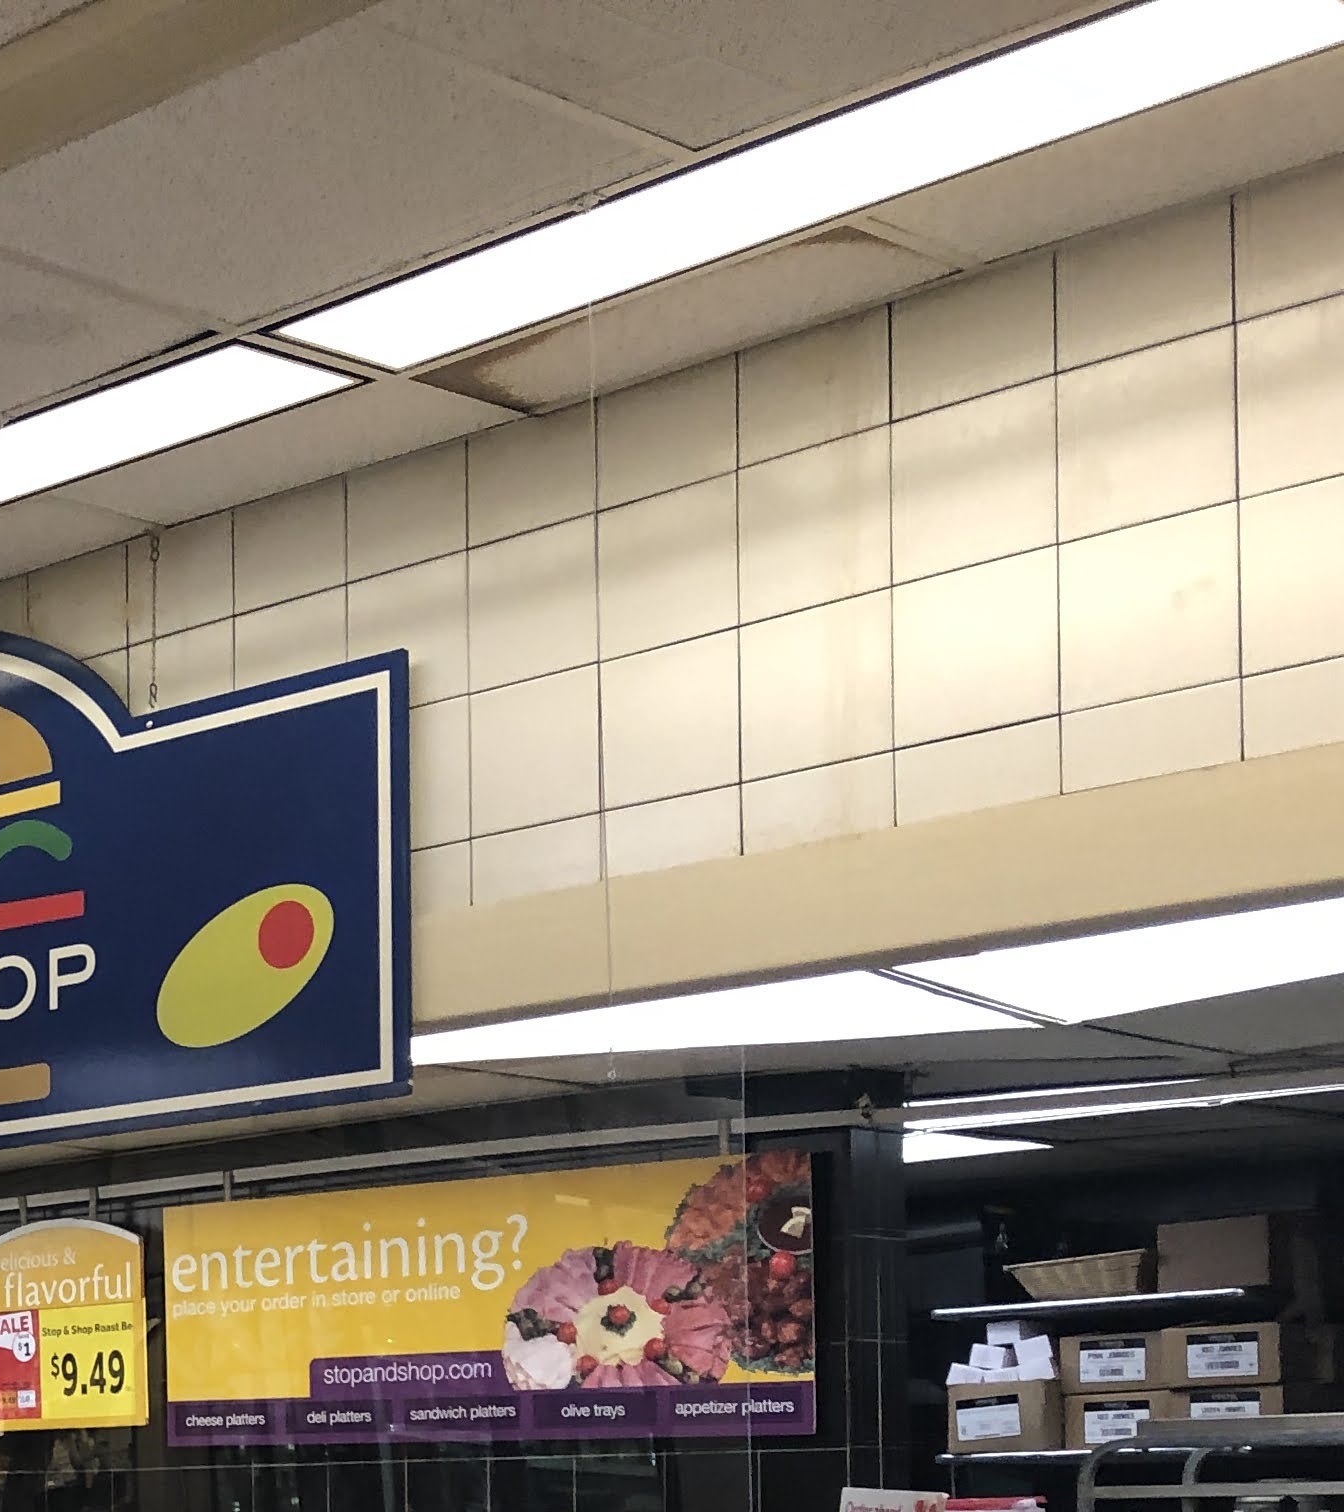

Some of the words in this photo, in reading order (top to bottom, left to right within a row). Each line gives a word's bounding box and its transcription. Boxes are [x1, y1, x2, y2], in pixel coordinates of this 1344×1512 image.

[63, 1247, 77, 1266] &
[171, 1213, 530, 1294] entertaining?
[4, 1261, 133, 1308] flavorful
[172, 1300, 216, 1319] place
[220, 1300, 256, 1318] your
[262, 1293, 307, 1312] order
[312, 1292, 329, 1308] in
[332, 1289, 376, 1308] store
[383, 1289, 400, 1304] or
[405, 1283, 462, 1304] online
[42, 1327, 62, 1338] Stop
[63, 1326, 70, 1336] &
[72, 1325, 94, 1336] Shop
[95, 1322, 120, 1333] Roast
[18, 1342, 31, 1357] $1
[50, 1349, 126, 1397] $9.49
[323, 1360, 492, 1388] stopandshop.com
[409, 1404, 468, 1421] sandwich
[470, 1402, 517, 1420] platters
[561, 1402, 591, 1418] olive
[593, 1402, 626, 1420] trays
[675, 1399, 737, 1418] appetizer
[741, 1397, 795, 1417] platters
[185, 1413, 223, 1428] cheese
[225, 1411, 266, 1428] platters
[306, 1411, 327, 1425] deli
[329, 1409, 372, 1426] platters
